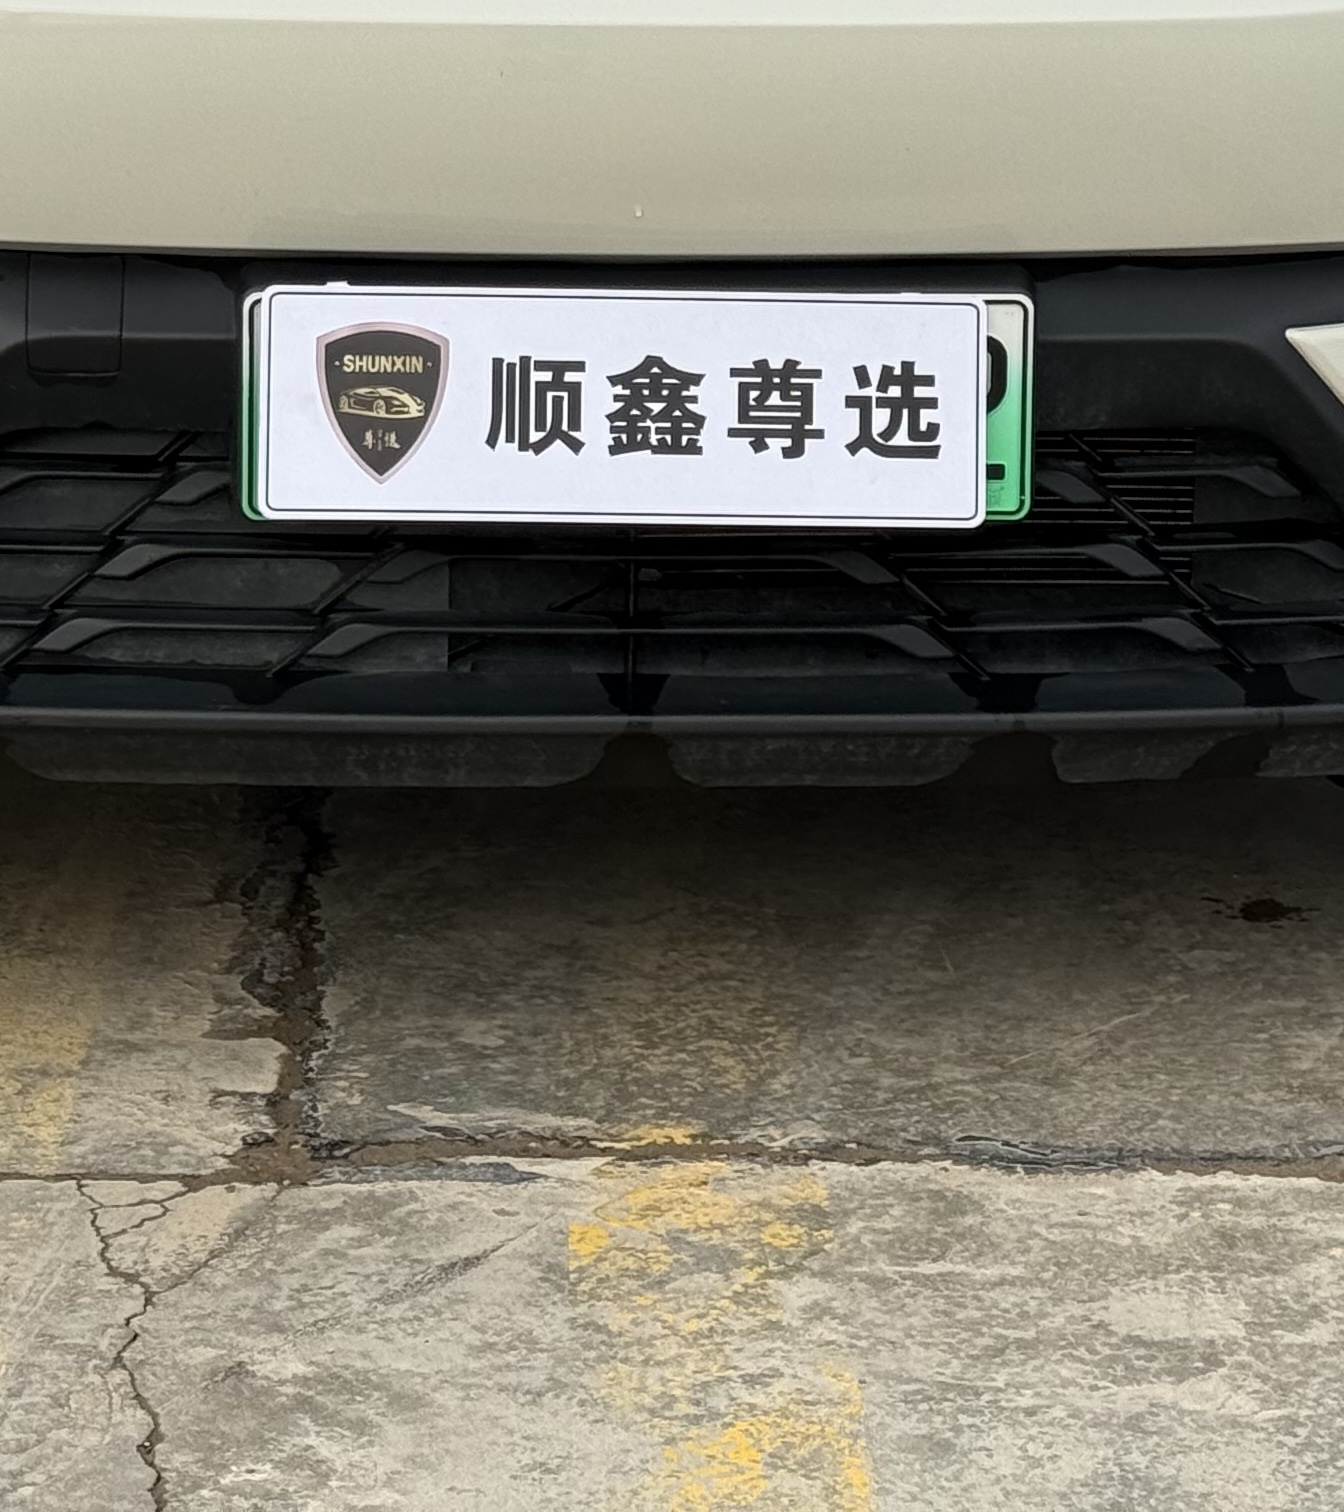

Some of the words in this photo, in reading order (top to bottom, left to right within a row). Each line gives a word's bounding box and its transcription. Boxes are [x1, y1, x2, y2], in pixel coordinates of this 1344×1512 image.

[342, 354, 424, 374] SHUNXIN
[484, 354, 942, 459] 顺鑫尊选
